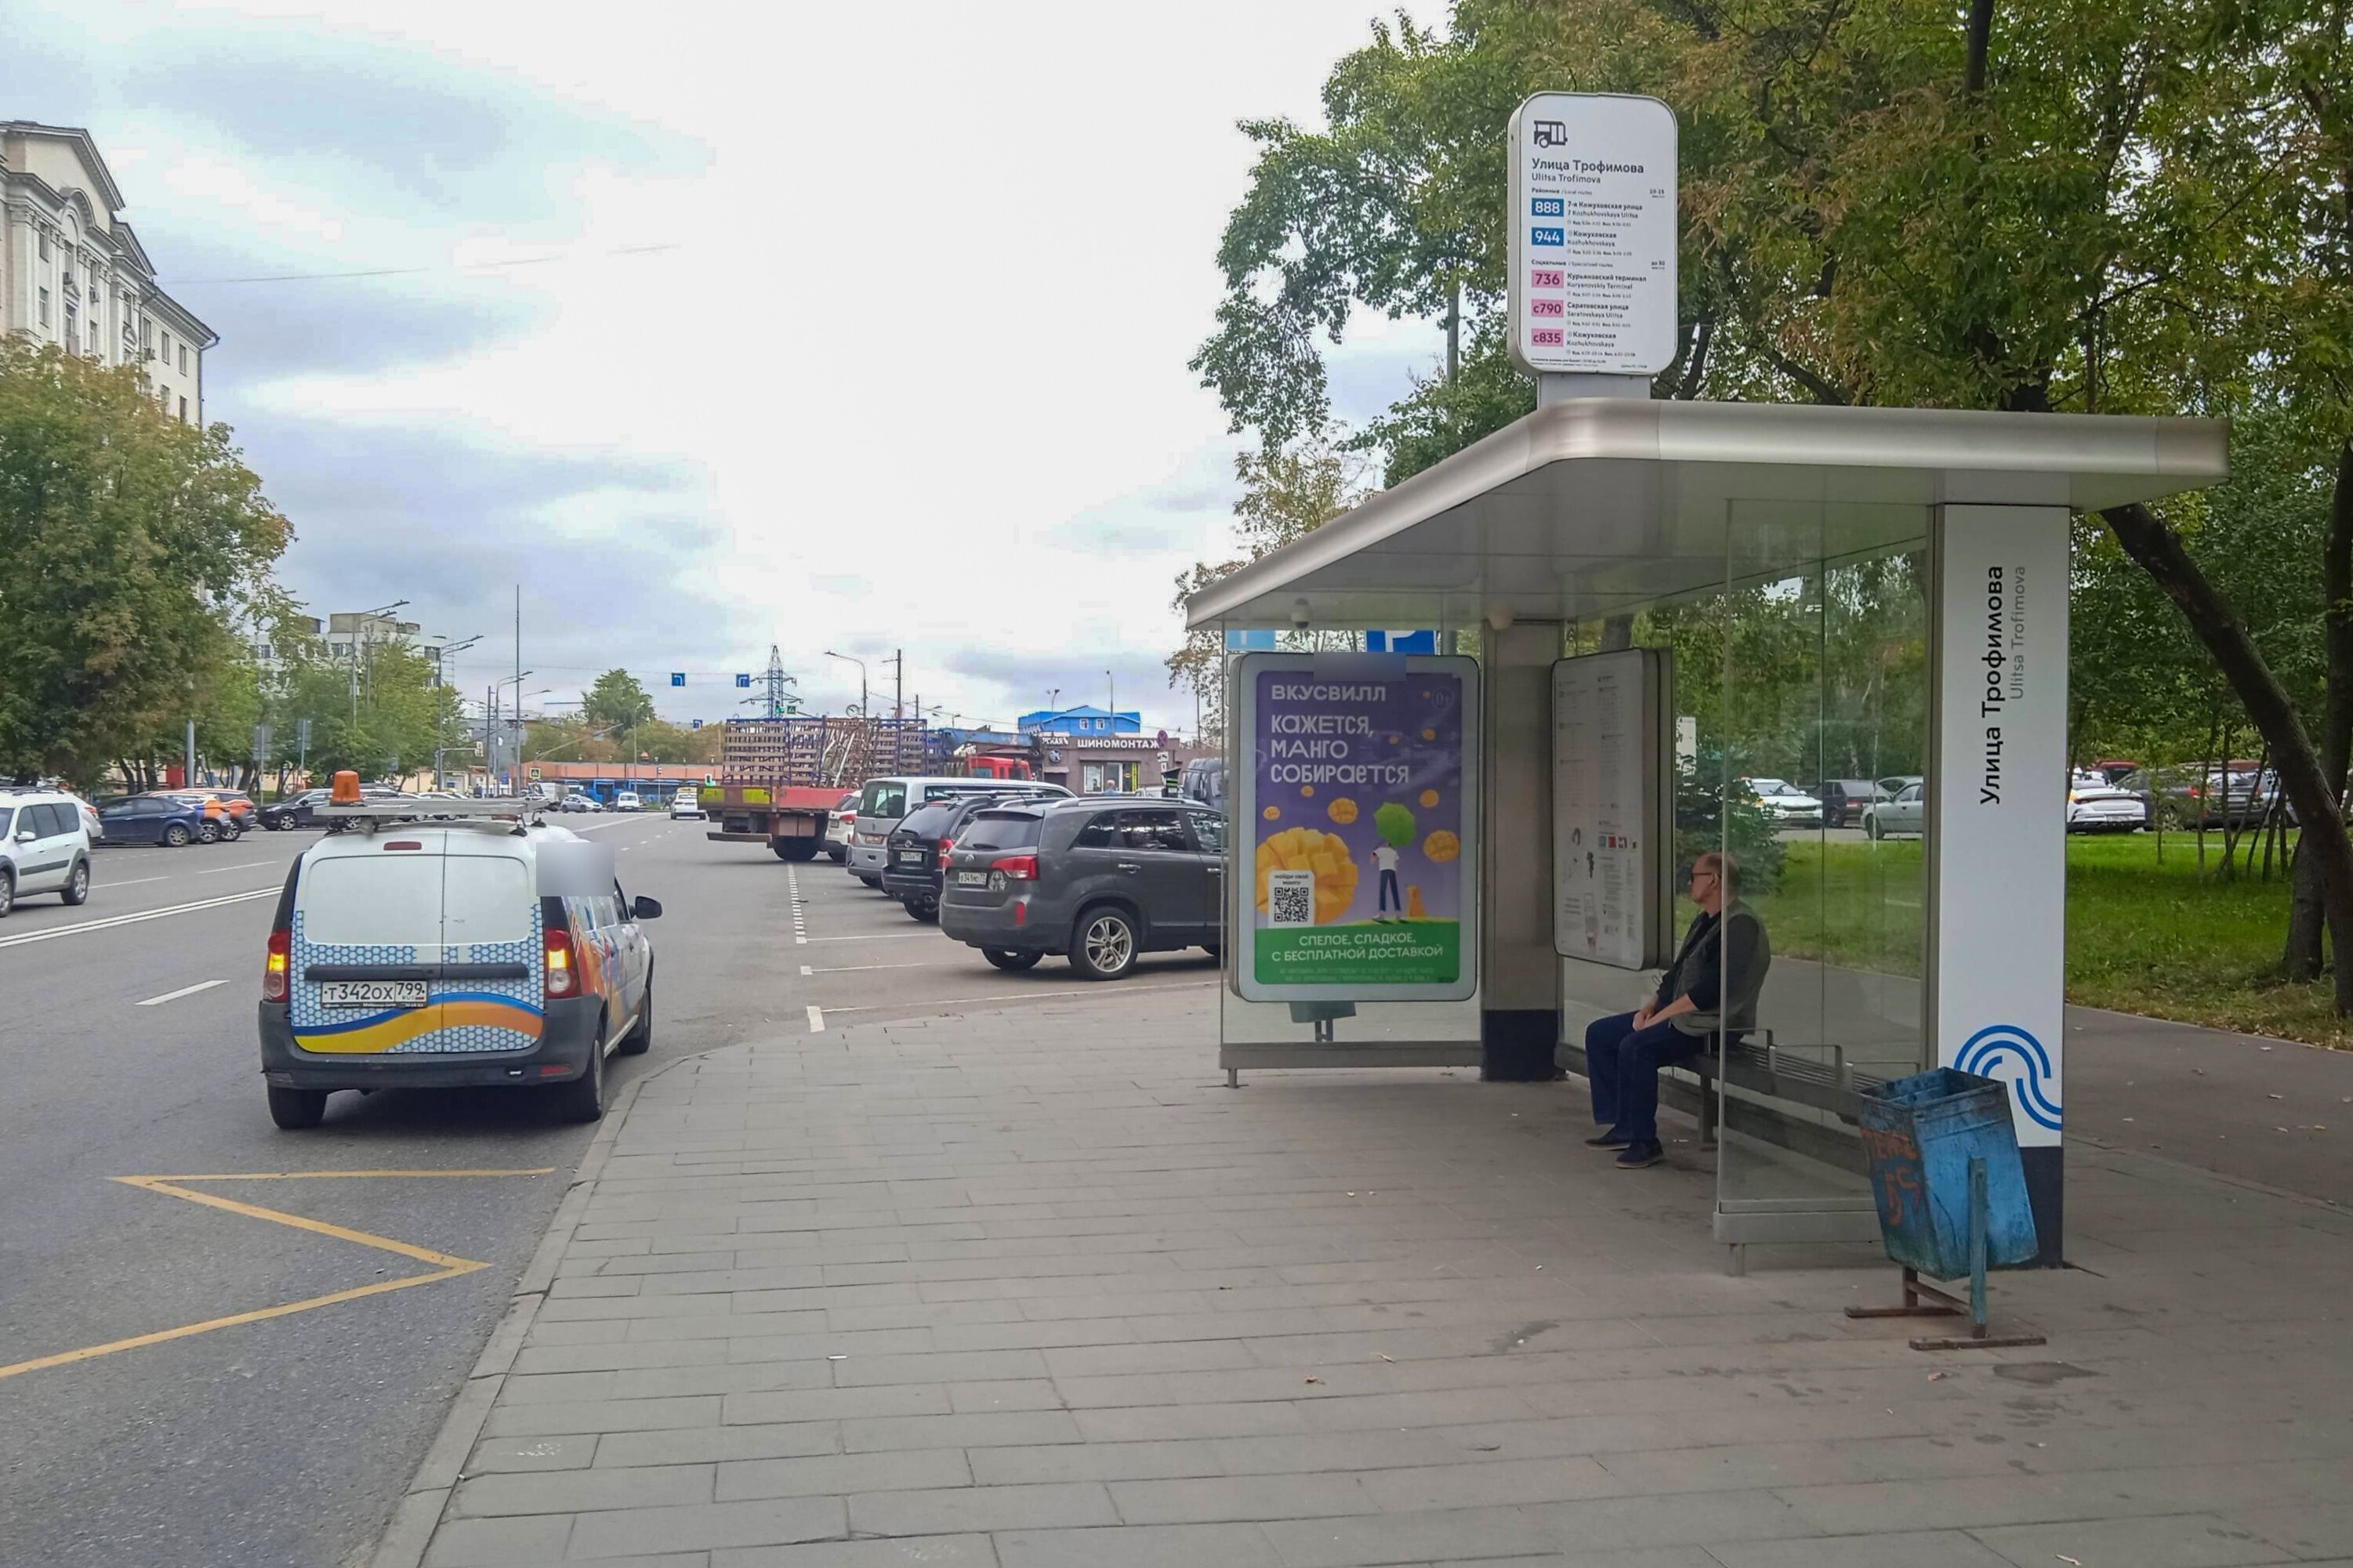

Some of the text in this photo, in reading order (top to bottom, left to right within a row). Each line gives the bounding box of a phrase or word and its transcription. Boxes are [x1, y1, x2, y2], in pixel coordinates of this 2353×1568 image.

[1532, 158, 1644, 173] Улица Трофимова
[1532, 173, 1601, 183] Ulitsa Trofimova
[1535, 201, 1560, 214] 888
[1535, 230, 1560, 243] 944
[1535, 273, 1560, 285] 736
[1533, 303, 1561, 314] с790
[1533, 332, 1561, 343] с835
[2010, 566, 2025, 700] Ulitsa Trofimova
[1980, 566, 2007, 805] Улица Трофимова
[1271, 685, 1386, 701] ВКУСВИЛЛ
[1077, 738, 1160, 749] ШИНОМОНТАЖ
[1271, 740, 1348, 759] МАНГО
[1354, 932, 1416, 945] СЛАДКОЕ,
[1271, 943, 1444, 961] С БЕСПЛАТНОЙ ДОСТАВКОЙ
[328, 983, 422, 1001] Т342ОХ 799
